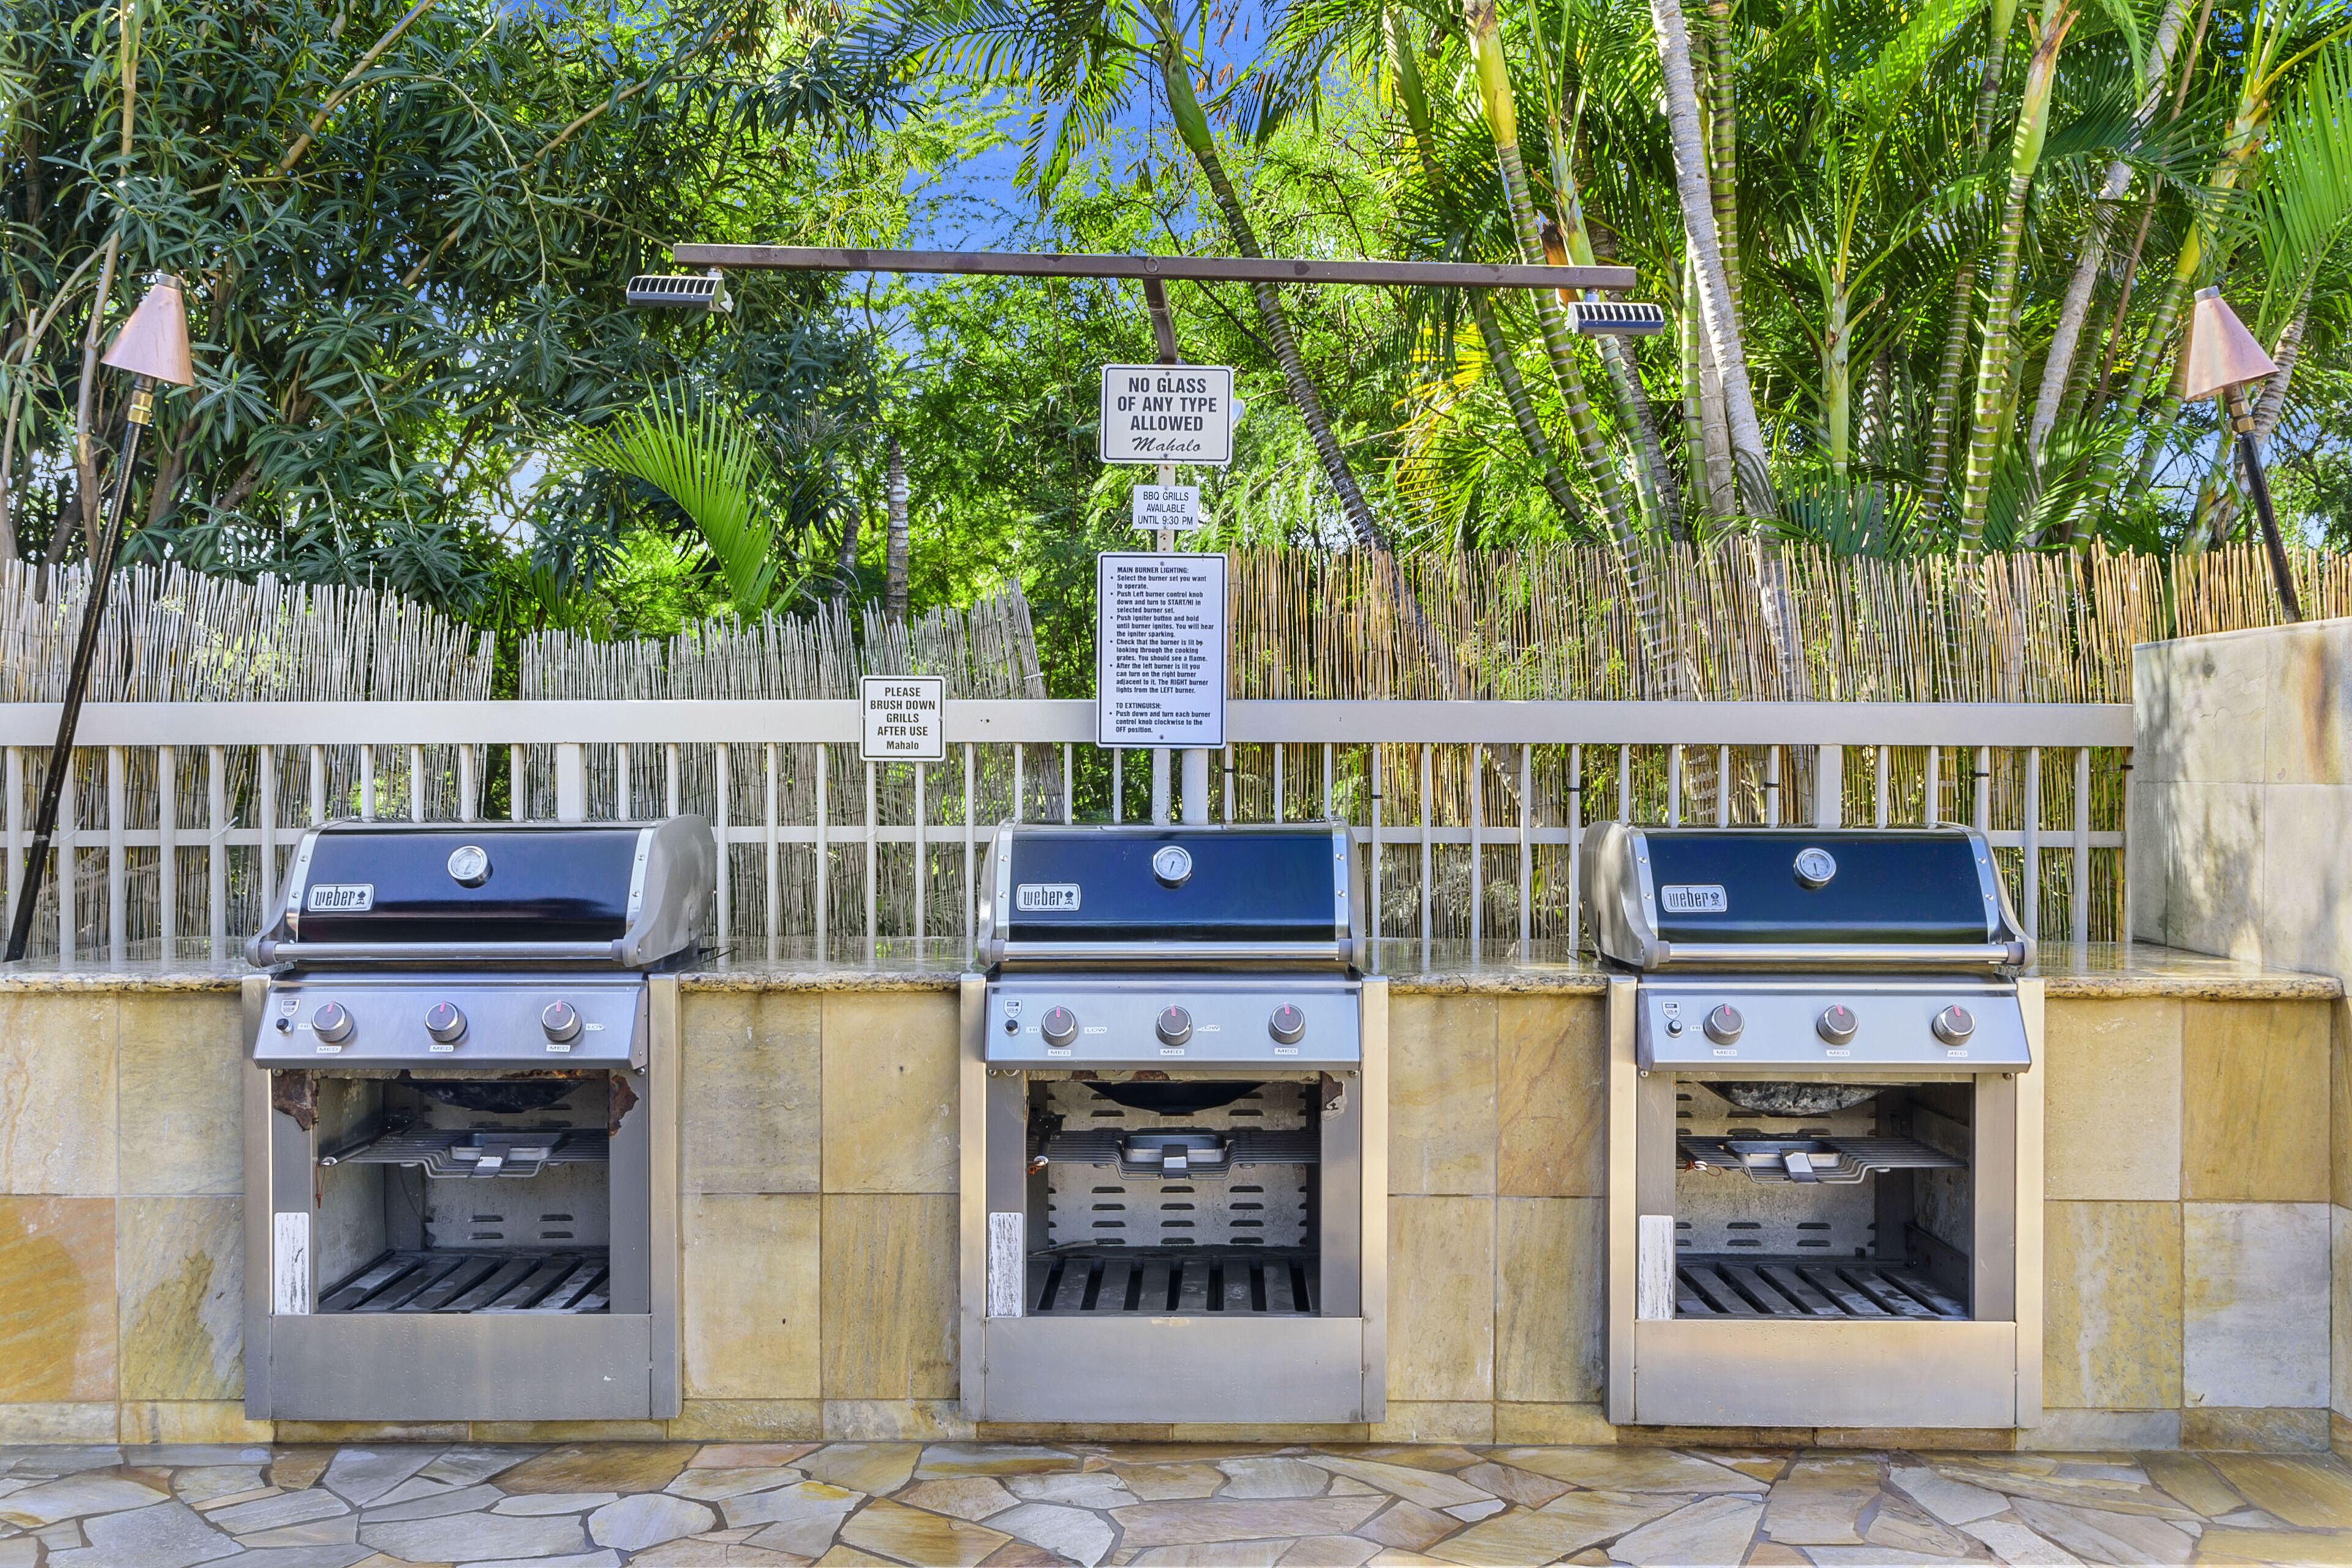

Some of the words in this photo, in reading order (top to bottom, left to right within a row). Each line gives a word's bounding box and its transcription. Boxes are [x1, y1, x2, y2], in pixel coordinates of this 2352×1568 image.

[1129, 377, 1150, 393] NO
[1157, 378, 1206, 393] GLASS
[1118, 396, 1136, 411] OF
[1142, 397, 1173, 412] ANY
[1180, 397, 1217, 412] TYPE
[1130, 415, 1204, 431] ALLOWED
[1132, 436, 1202, 451] Mahalo
[1143, 492, 1159, 500] BBQ
[1163, 492, 1189, 500] GRILLS
[1147, 504, 1185, 513] AVAILABLE
[1138, 516, 1159, 524] UNTIL
[1162, 516, 1178, 525] 9:30
[885, 687, 921, 696] PLEASE
[870, 701, 902, 710] BRUSH
[906, 701, 935, 710] DOWN
[887, 714, 919, 723] GRILLS
[878, 726, 906, 736] AFTER
[910, 726, 928, 736] USE
[887, 741, 919, 750] Mahalo
[315, 886, 355, 906] weber
[1023, 886, 1063, 906] weber
[1668, 888, 1708, 907] weber
